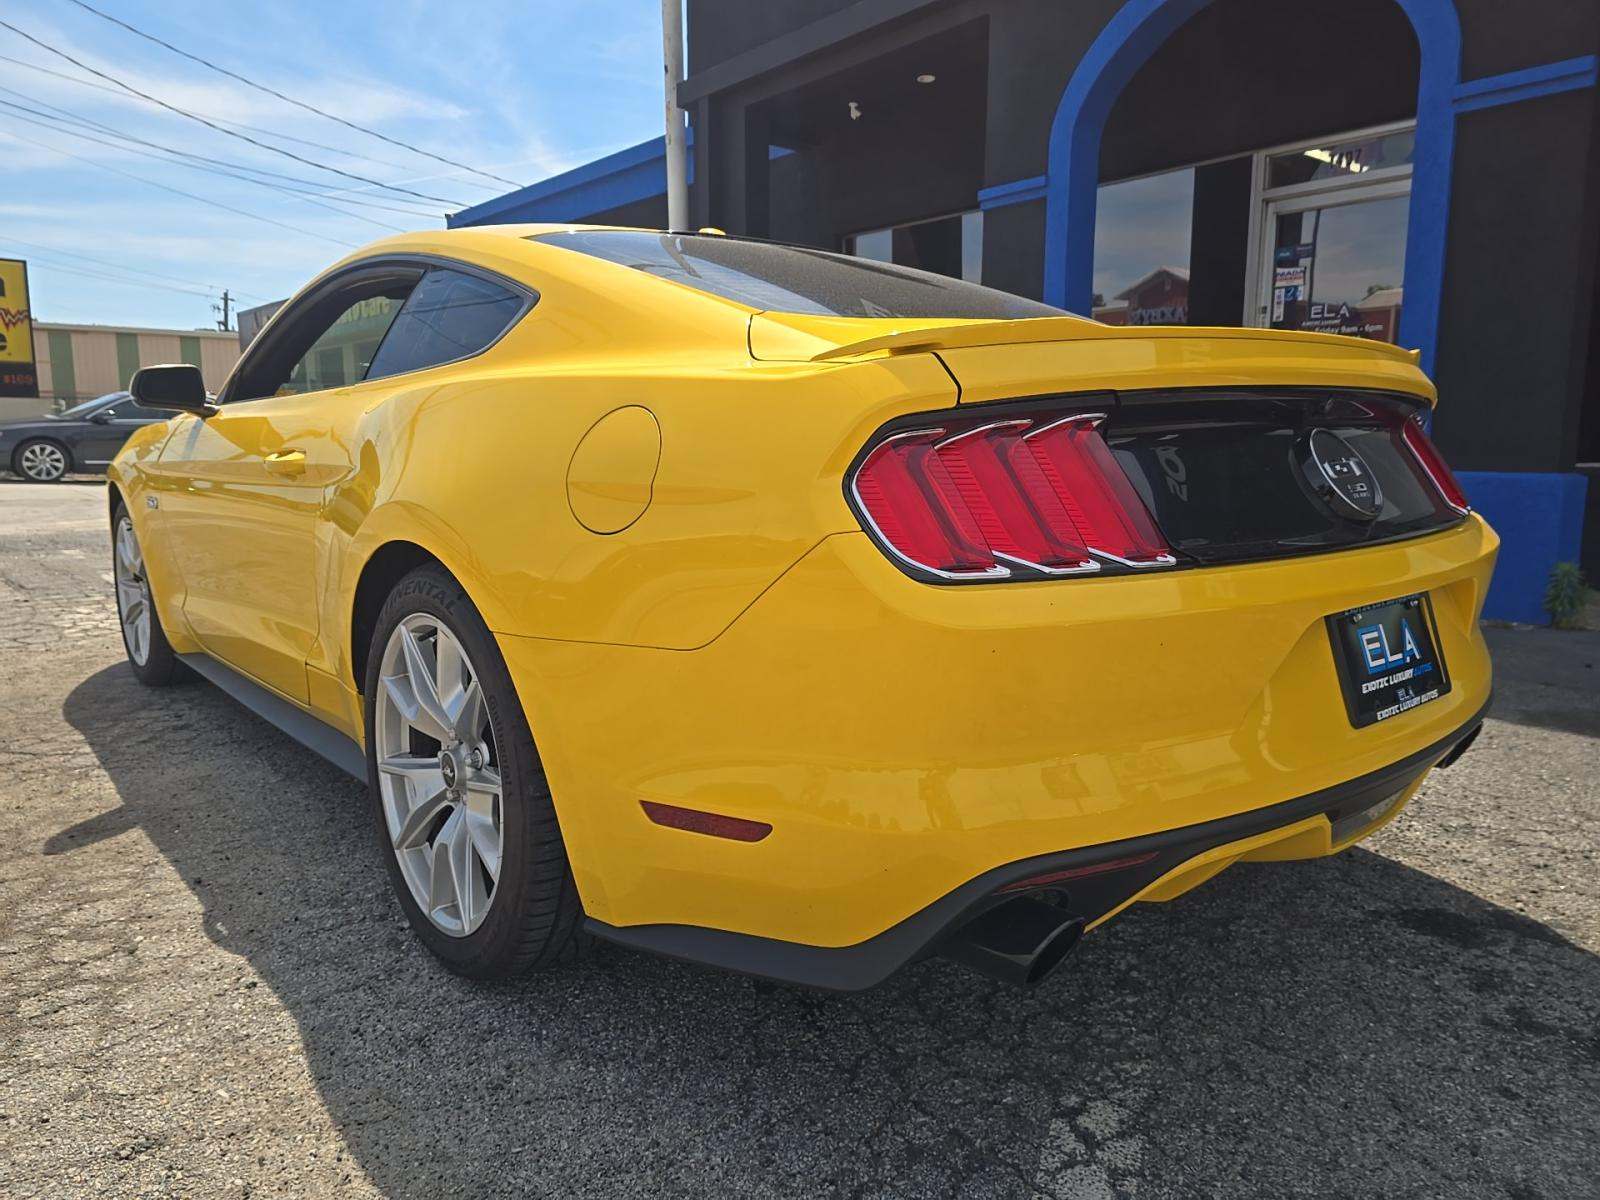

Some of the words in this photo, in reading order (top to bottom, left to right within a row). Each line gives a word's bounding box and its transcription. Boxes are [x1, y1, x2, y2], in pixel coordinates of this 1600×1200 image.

[1311, 303, 1350, 319] ELA
[1357, 619, 1421, 674] ELA
[1361, 676, 1389, 694] EXOTIC
